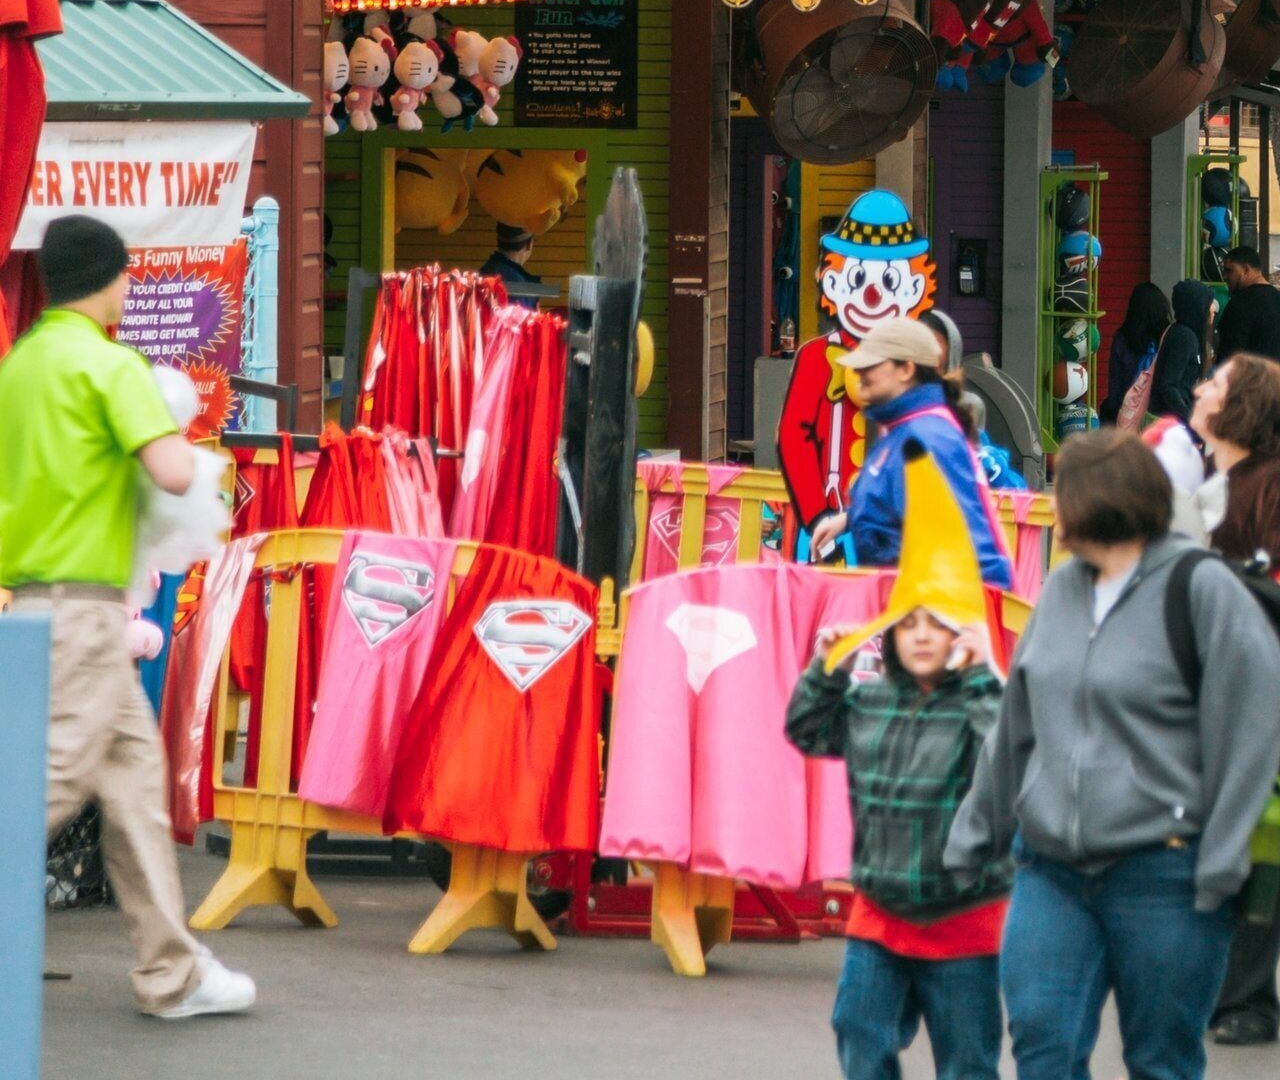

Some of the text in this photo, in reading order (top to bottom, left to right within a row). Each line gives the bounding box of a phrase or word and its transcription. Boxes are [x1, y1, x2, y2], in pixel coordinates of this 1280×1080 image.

[28, 161, 239, 207] ER EVERY TIME"
[126, 246, 225, 269] es Funny Money
[132, 284, 156, 295] YOUR
[157, 282, 184, 294] CREDIT
[136, 299, 158, 310] PLAY
[158, 299, 172, 309] ALL
[173, 297, 194, 308] YOUR
[121, 312, 194, 326] FAVORITE MIDWAY
[115, 327, 200, 341] AMES AND GET MORE
[161, 343, 187, 355] BUCK!
